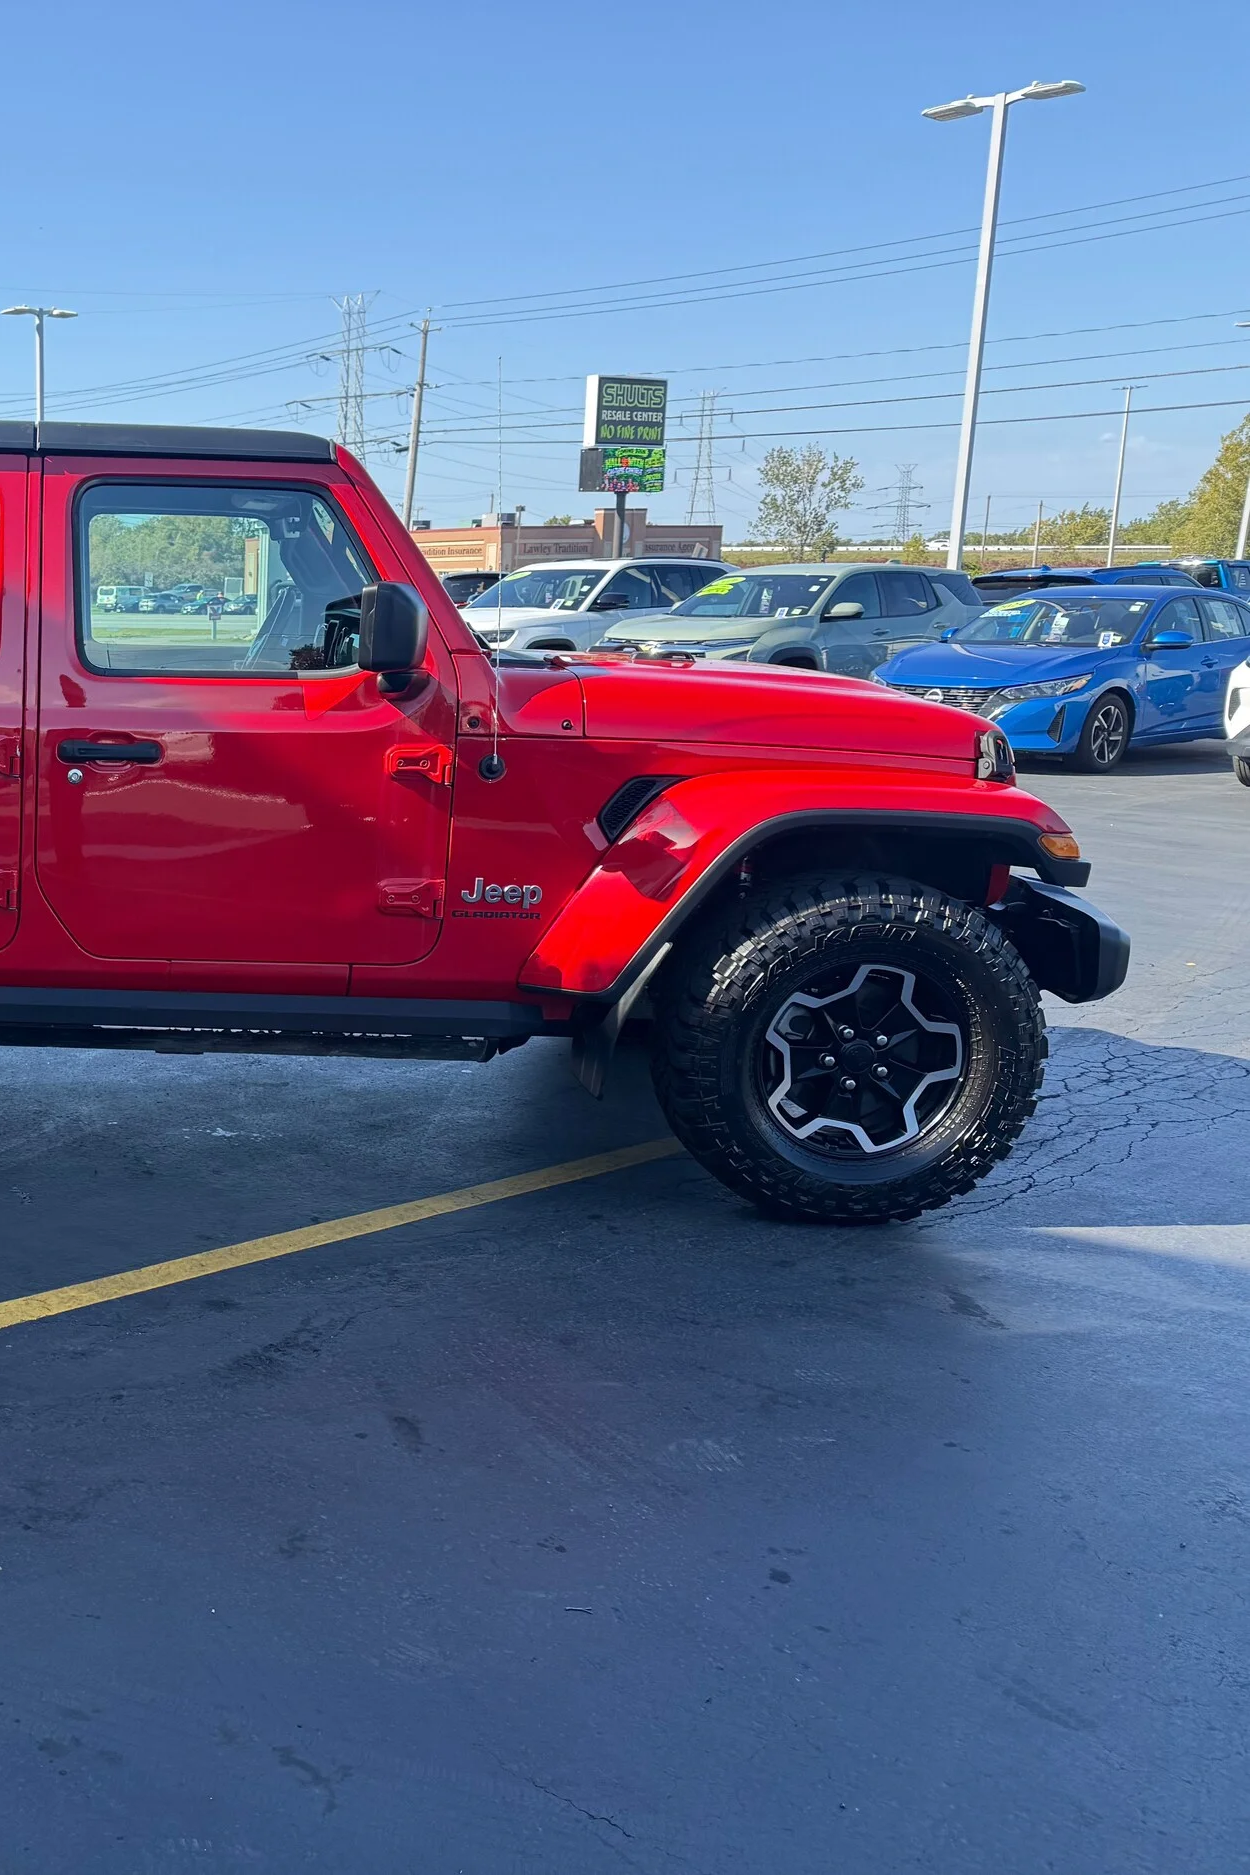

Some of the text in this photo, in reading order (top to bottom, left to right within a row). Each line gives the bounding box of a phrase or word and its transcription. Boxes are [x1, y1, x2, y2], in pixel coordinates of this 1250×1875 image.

[603, 383, 665, 408] SHULTS
[601, 410, 663, 423] RESALE CENTER
[600, 424, 662, 441] NO FINE PRINT
[448, 547, 482, 555] Insurance
[524, 543, 551, 555] Lawley
[461, 877, 542, 909] Jeep
[452, 910, 540, 920] GLADIATOR
